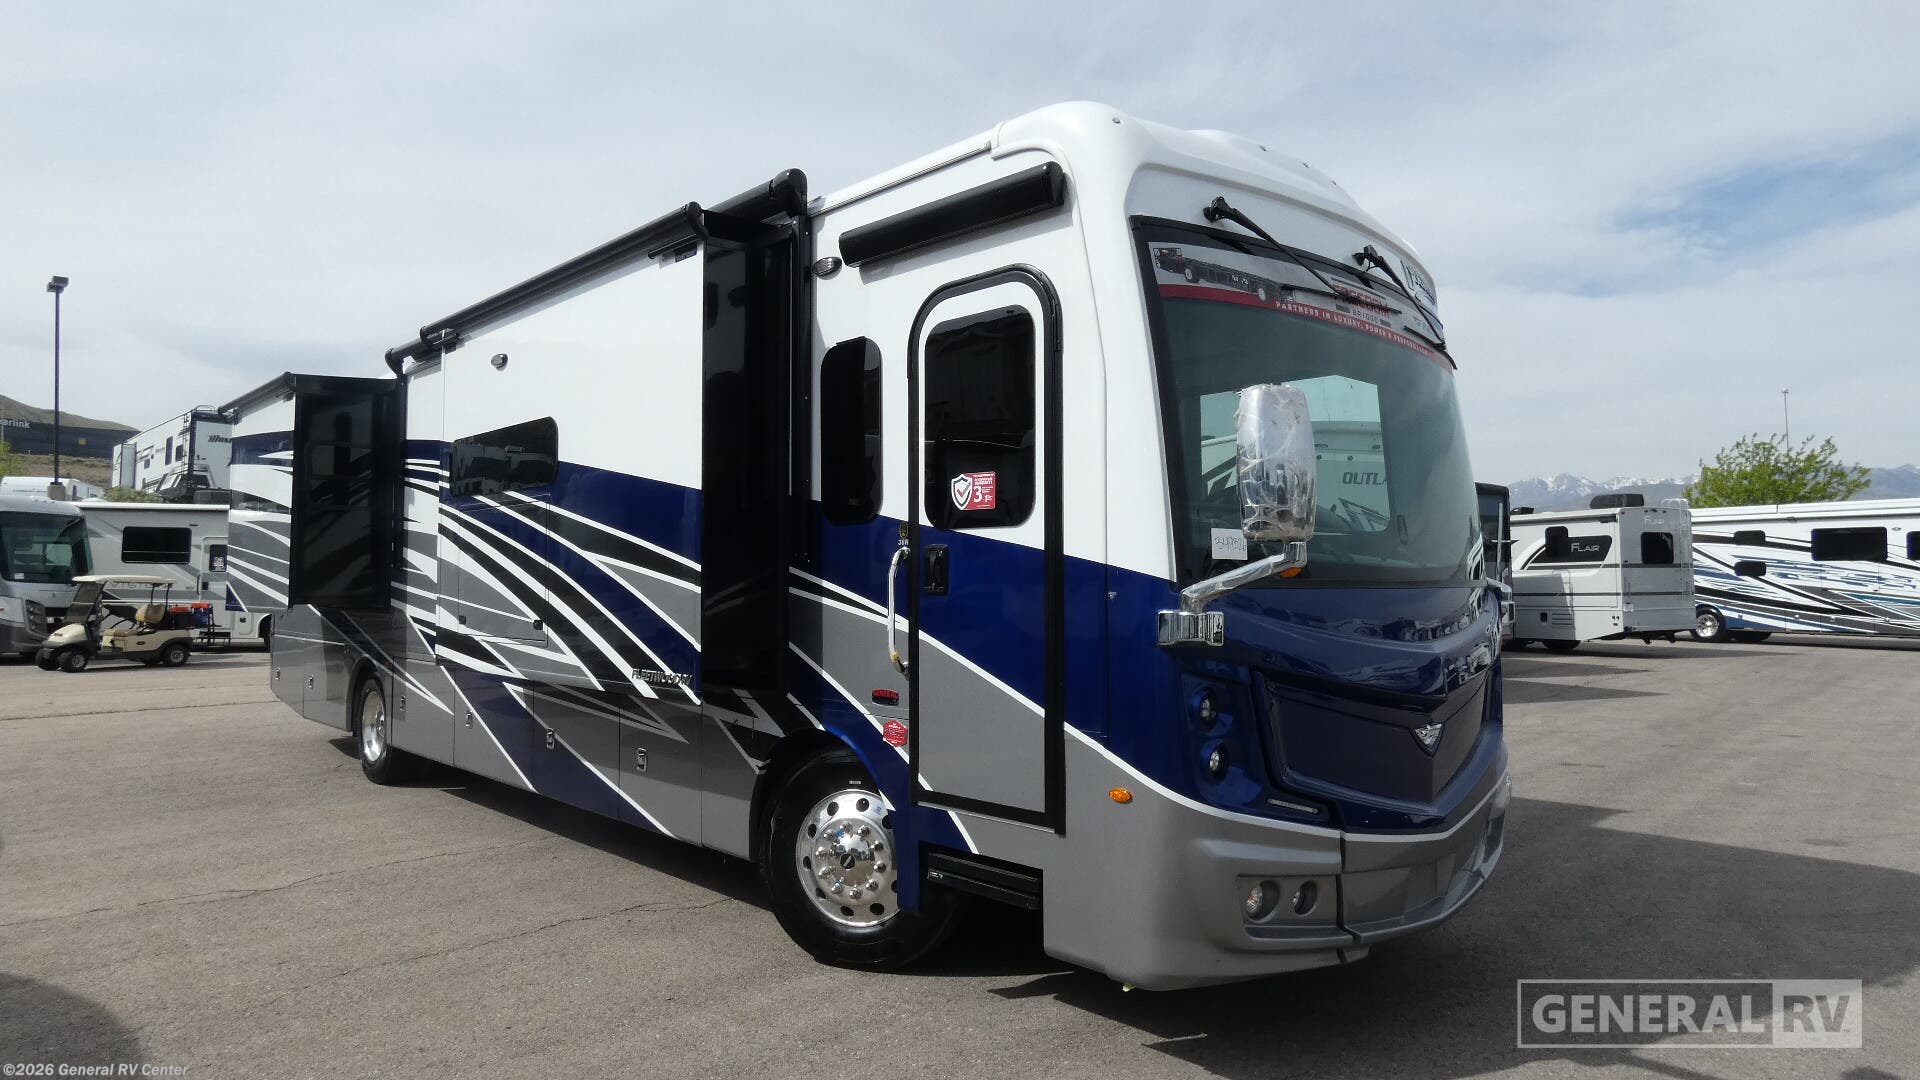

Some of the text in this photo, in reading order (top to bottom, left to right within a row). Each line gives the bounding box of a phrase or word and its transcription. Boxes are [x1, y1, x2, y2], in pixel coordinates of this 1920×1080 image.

[1275, 300, 1319, 318] PARTNERS
[1322, 311, 1331, 320] IN
[1570, 542, 1601, 553] FLAIR
